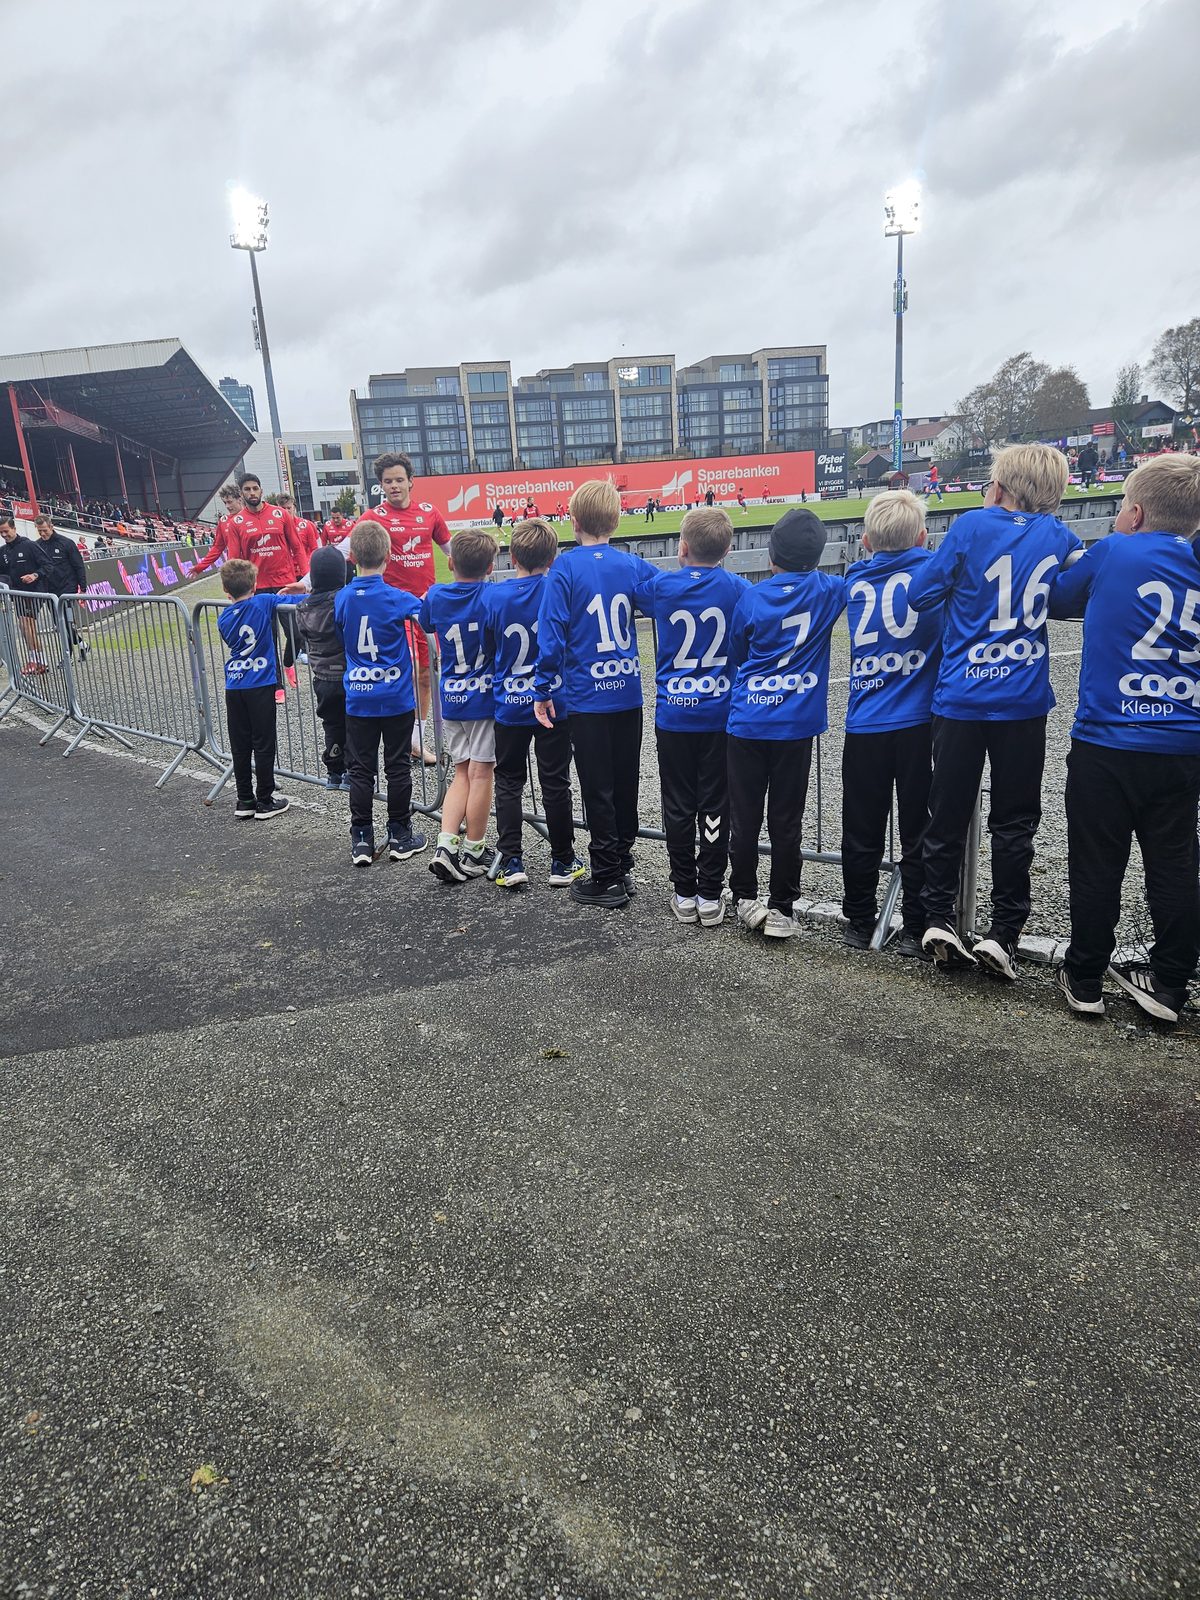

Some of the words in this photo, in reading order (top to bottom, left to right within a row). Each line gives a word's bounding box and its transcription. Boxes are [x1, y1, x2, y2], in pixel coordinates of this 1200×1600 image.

[893, 414, 902, 470] CraneNorway
[817, 454, 845, 465] Øster
[698, 465, 780, 483] Sparebanken
[824, 464, 843, 474] Hus
[485, 480, 574, 497] Sparebanken
[698, 482, 736, 495] Norge
[486, 497, 527, 511] Norge
[390, 552, 431, 561] Sparebanken
[403, 560, 424, 568] Norge
[984, 554, 1059, 632] 16
[850, 572, 919, 647] 20
[586, 593, 632, 653] 10
[239, 624, 257, 657] 3
[357, 615, 379, 662] 4
[669, 607, 728, 669] 22
[777, 611, 811, 669] 7
[504, 620, 539, 675] 2
[968, 638, 1046, 666] coop
[228, 656, 268, 673] coop
[590, 656, 641, 679] coop
[852, 649, 927, 677] coop
[348, 666, 401, 683] coop
[965, 665, 1011, 680] Klepp
[349, 682, 374, 692] Klepp
[444, 673, 494, 693] coop
[594, 679, 626, 691] Klepp
[666, 675, 731, 697] coop
[747, 671, 818, 694] coop
[851, 678, 884, 691] Klepp
[444, 693, 468, 704] Klepp
[504, 694, 533, 705] Klepp
[666, 694, 699, 708] Klepp
[746, 693, 784, 706] Klepp
[1121, 700, 1174, 717] Klepp
